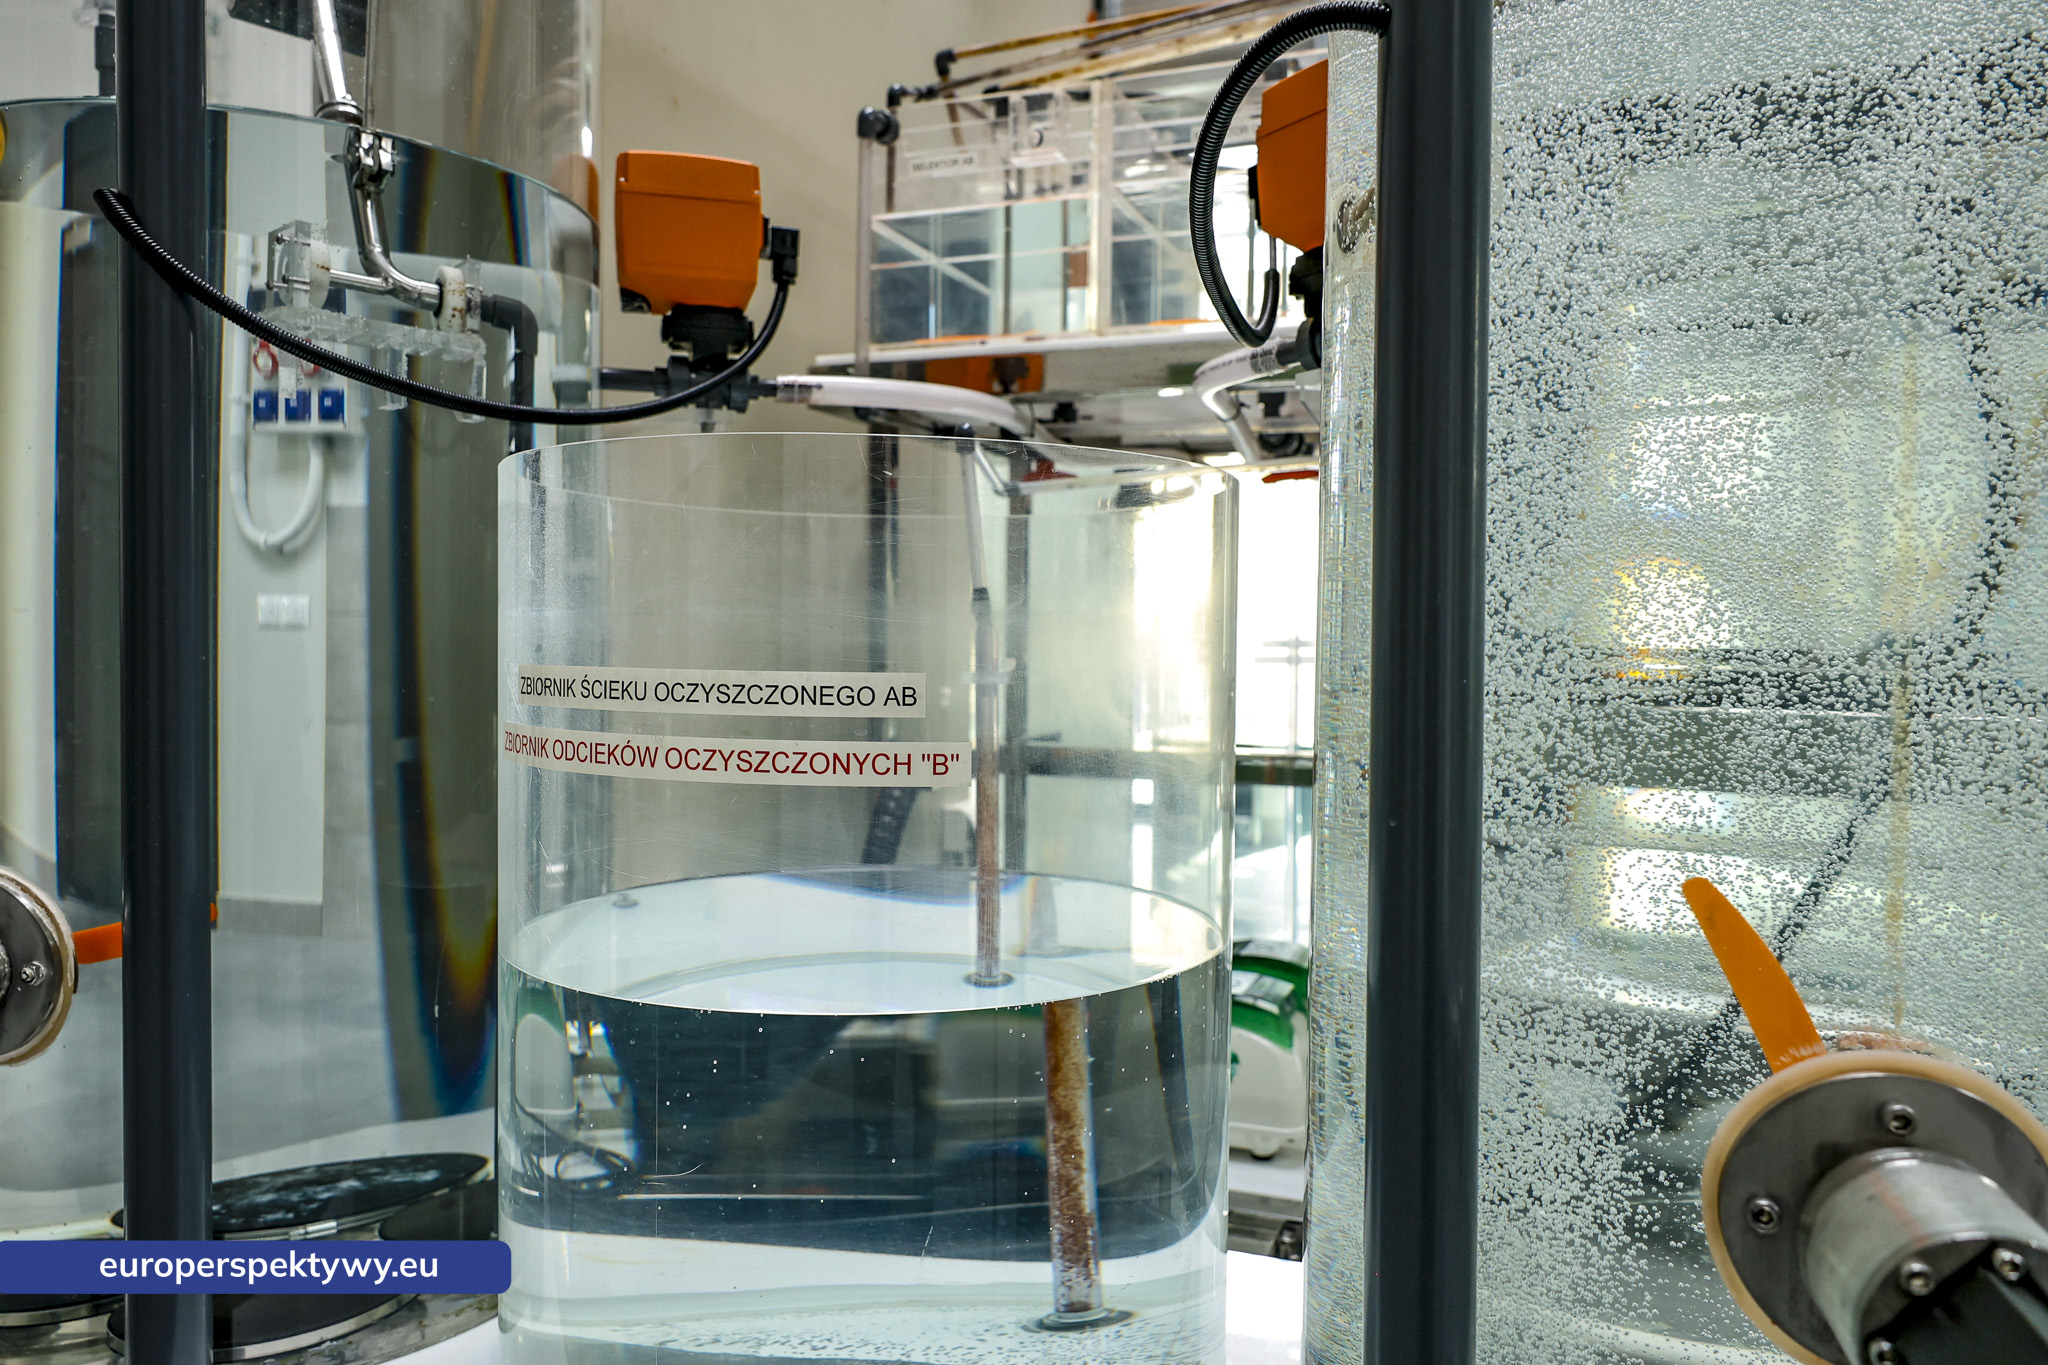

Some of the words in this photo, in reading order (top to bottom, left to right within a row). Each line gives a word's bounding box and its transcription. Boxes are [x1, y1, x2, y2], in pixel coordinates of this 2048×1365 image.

[521, 676, 576, 698] ZBIORNIK
[580, 674, 647, 701] ŚCIEKU
[654, 681, 876, 707] OCZYSZCZONEGO
[883, 686, 918, 707] AB
[504, 731, 549, 759] ZBIORNIK
[552, 739, 659, 768] ODCIEKÓW
[665, 746, 912, 776] OCZYSZCZONYCH
[921, 753, 960, 776] "B"
